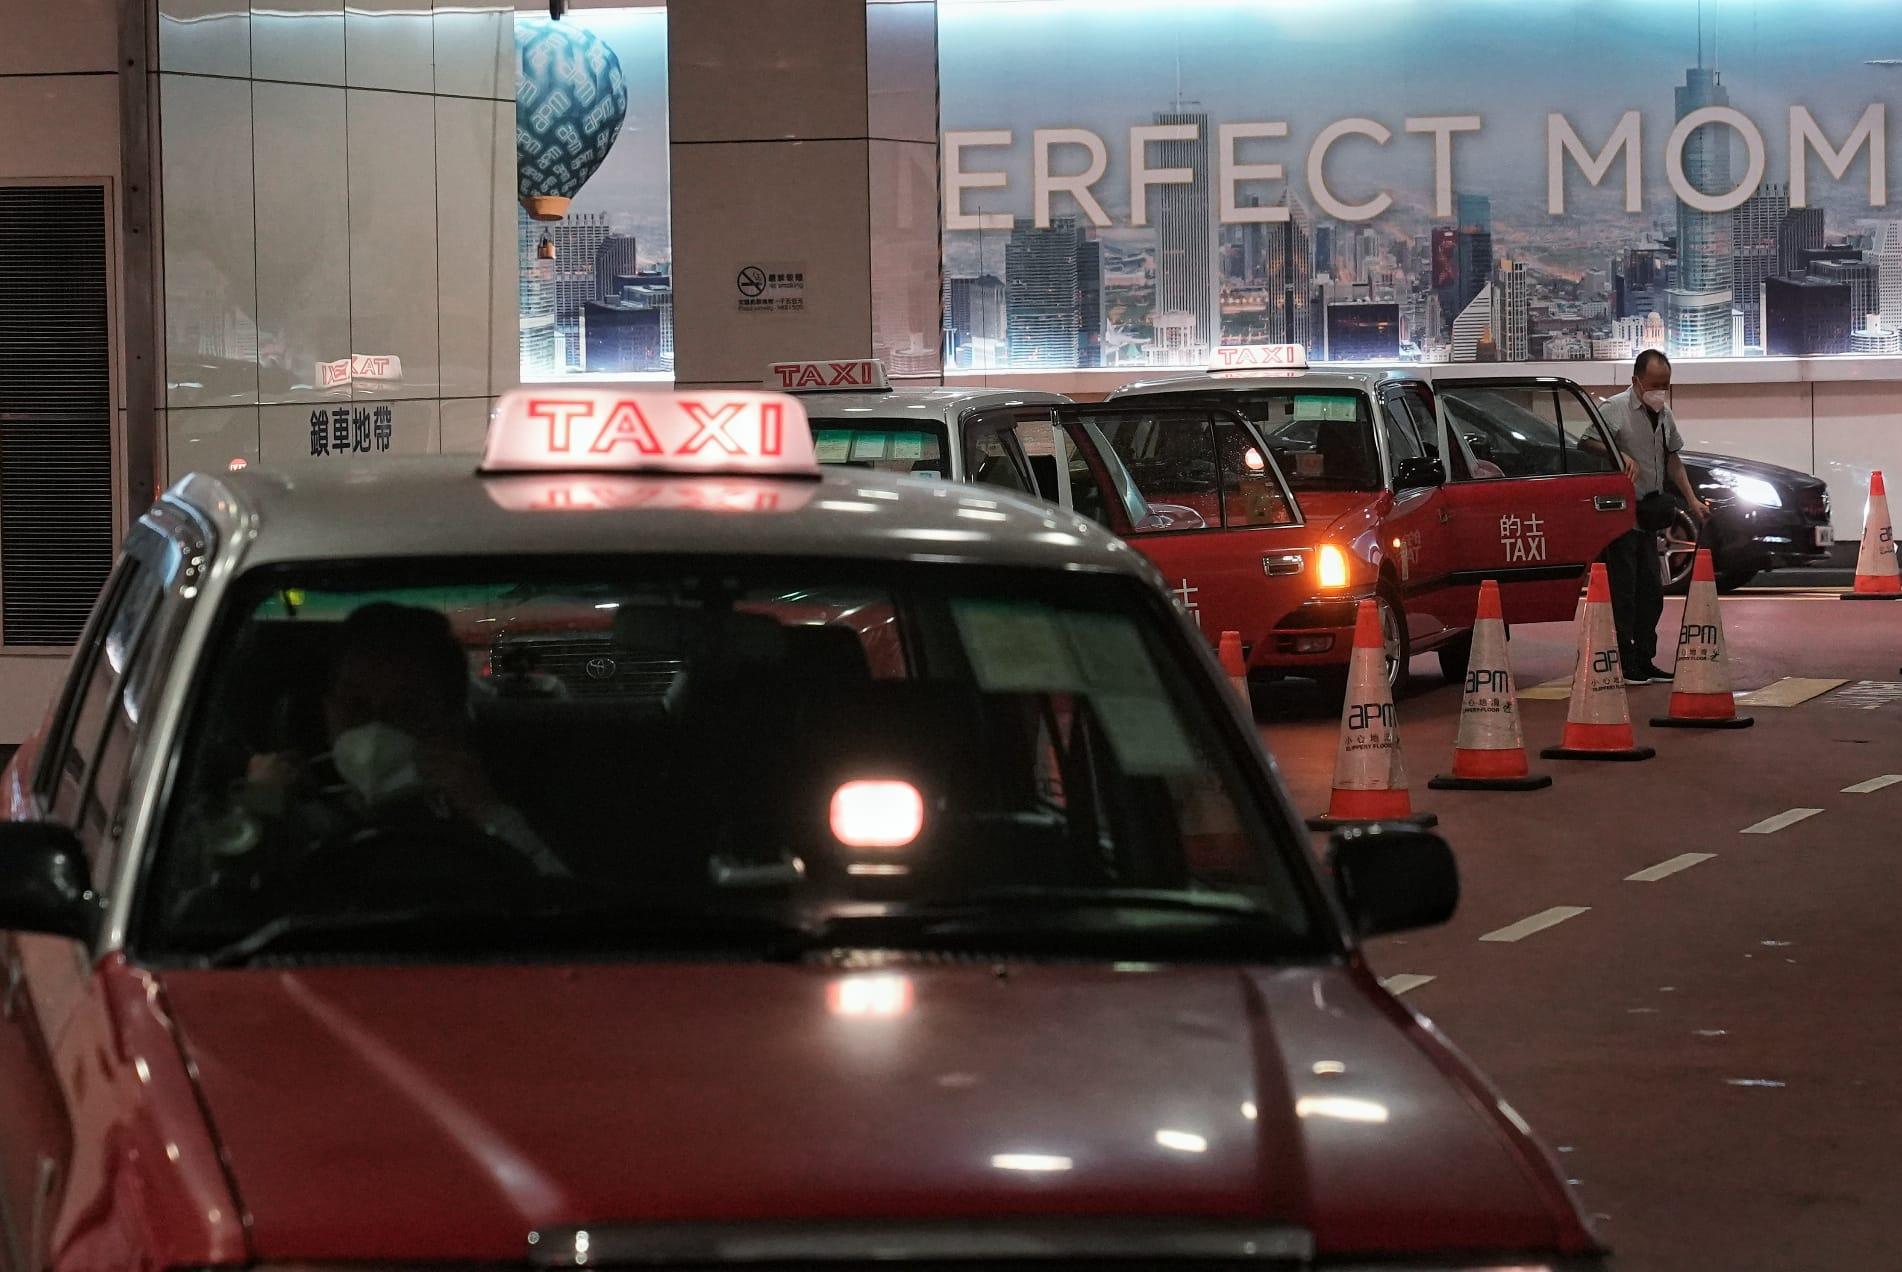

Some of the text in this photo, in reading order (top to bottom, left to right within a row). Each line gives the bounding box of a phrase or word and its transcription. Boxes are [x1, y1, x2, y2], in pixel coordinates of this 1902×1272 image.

[532, 90, 570, 132] apm
[584, 98, 615, 134] apm
[944, 103, 1886, 229] ERFECT MOM
[1218, 347, 1294, 365] TAXI
[774, 362, 872, 387] TAXI
[310, 405, 392, 457] 鎖車地帶
[527, 400, 784, 456] TAXI
[1500, 513, 1545, 537] 的士
[1501, 537, 1546, 562] TAXI
[1170, 578, 1199, 608] 士
[1680, 625, 1717, 645] apm
[1466, 669, 1509, 694] apm
[1348, 703, 1397, 730] apm
